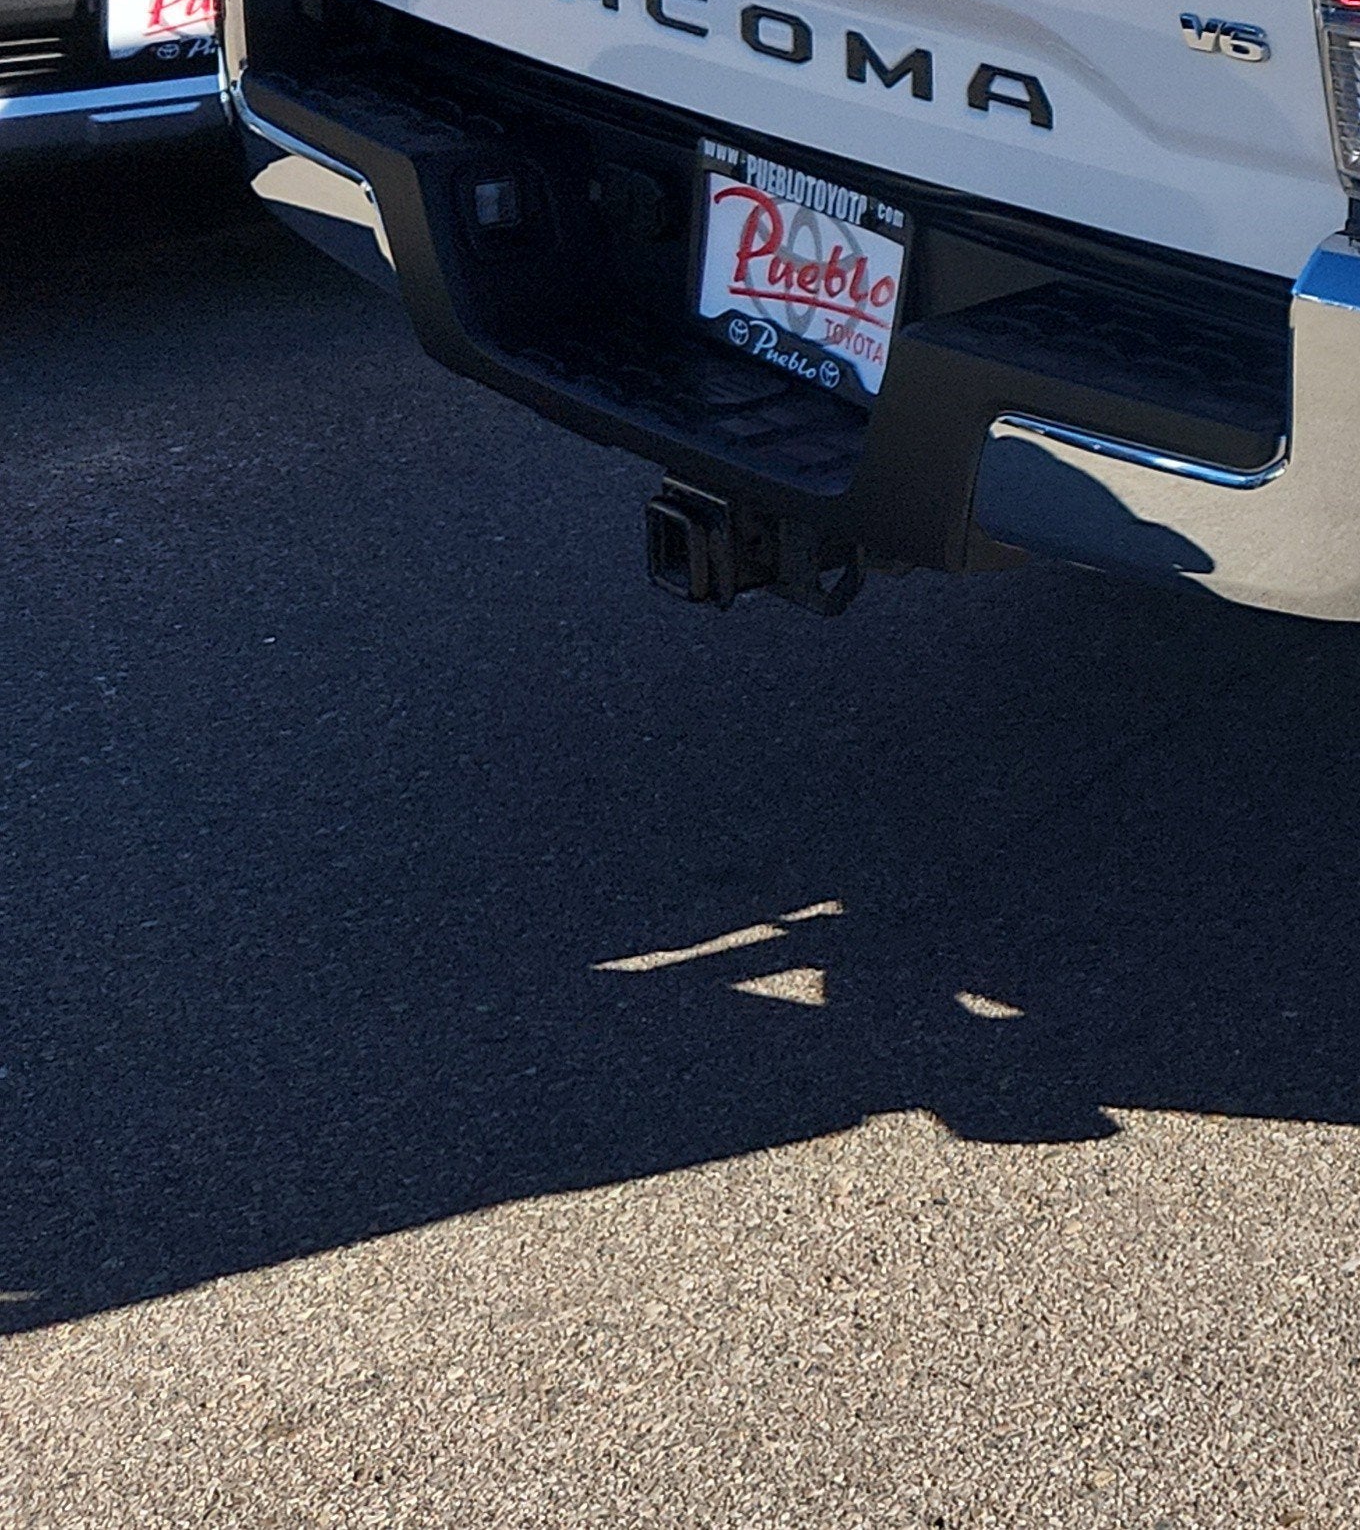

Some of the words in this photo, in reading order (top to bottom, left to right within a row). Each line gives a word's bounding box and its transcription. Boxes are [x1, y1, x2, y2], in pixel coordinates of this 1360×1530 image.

[1178, 11, 1273, 63] V6
[713, 186, 896, 308] Pueblo
[749, 319, 818, 380] Pueblo
[824, 318, 884, 366] TOYOTA
